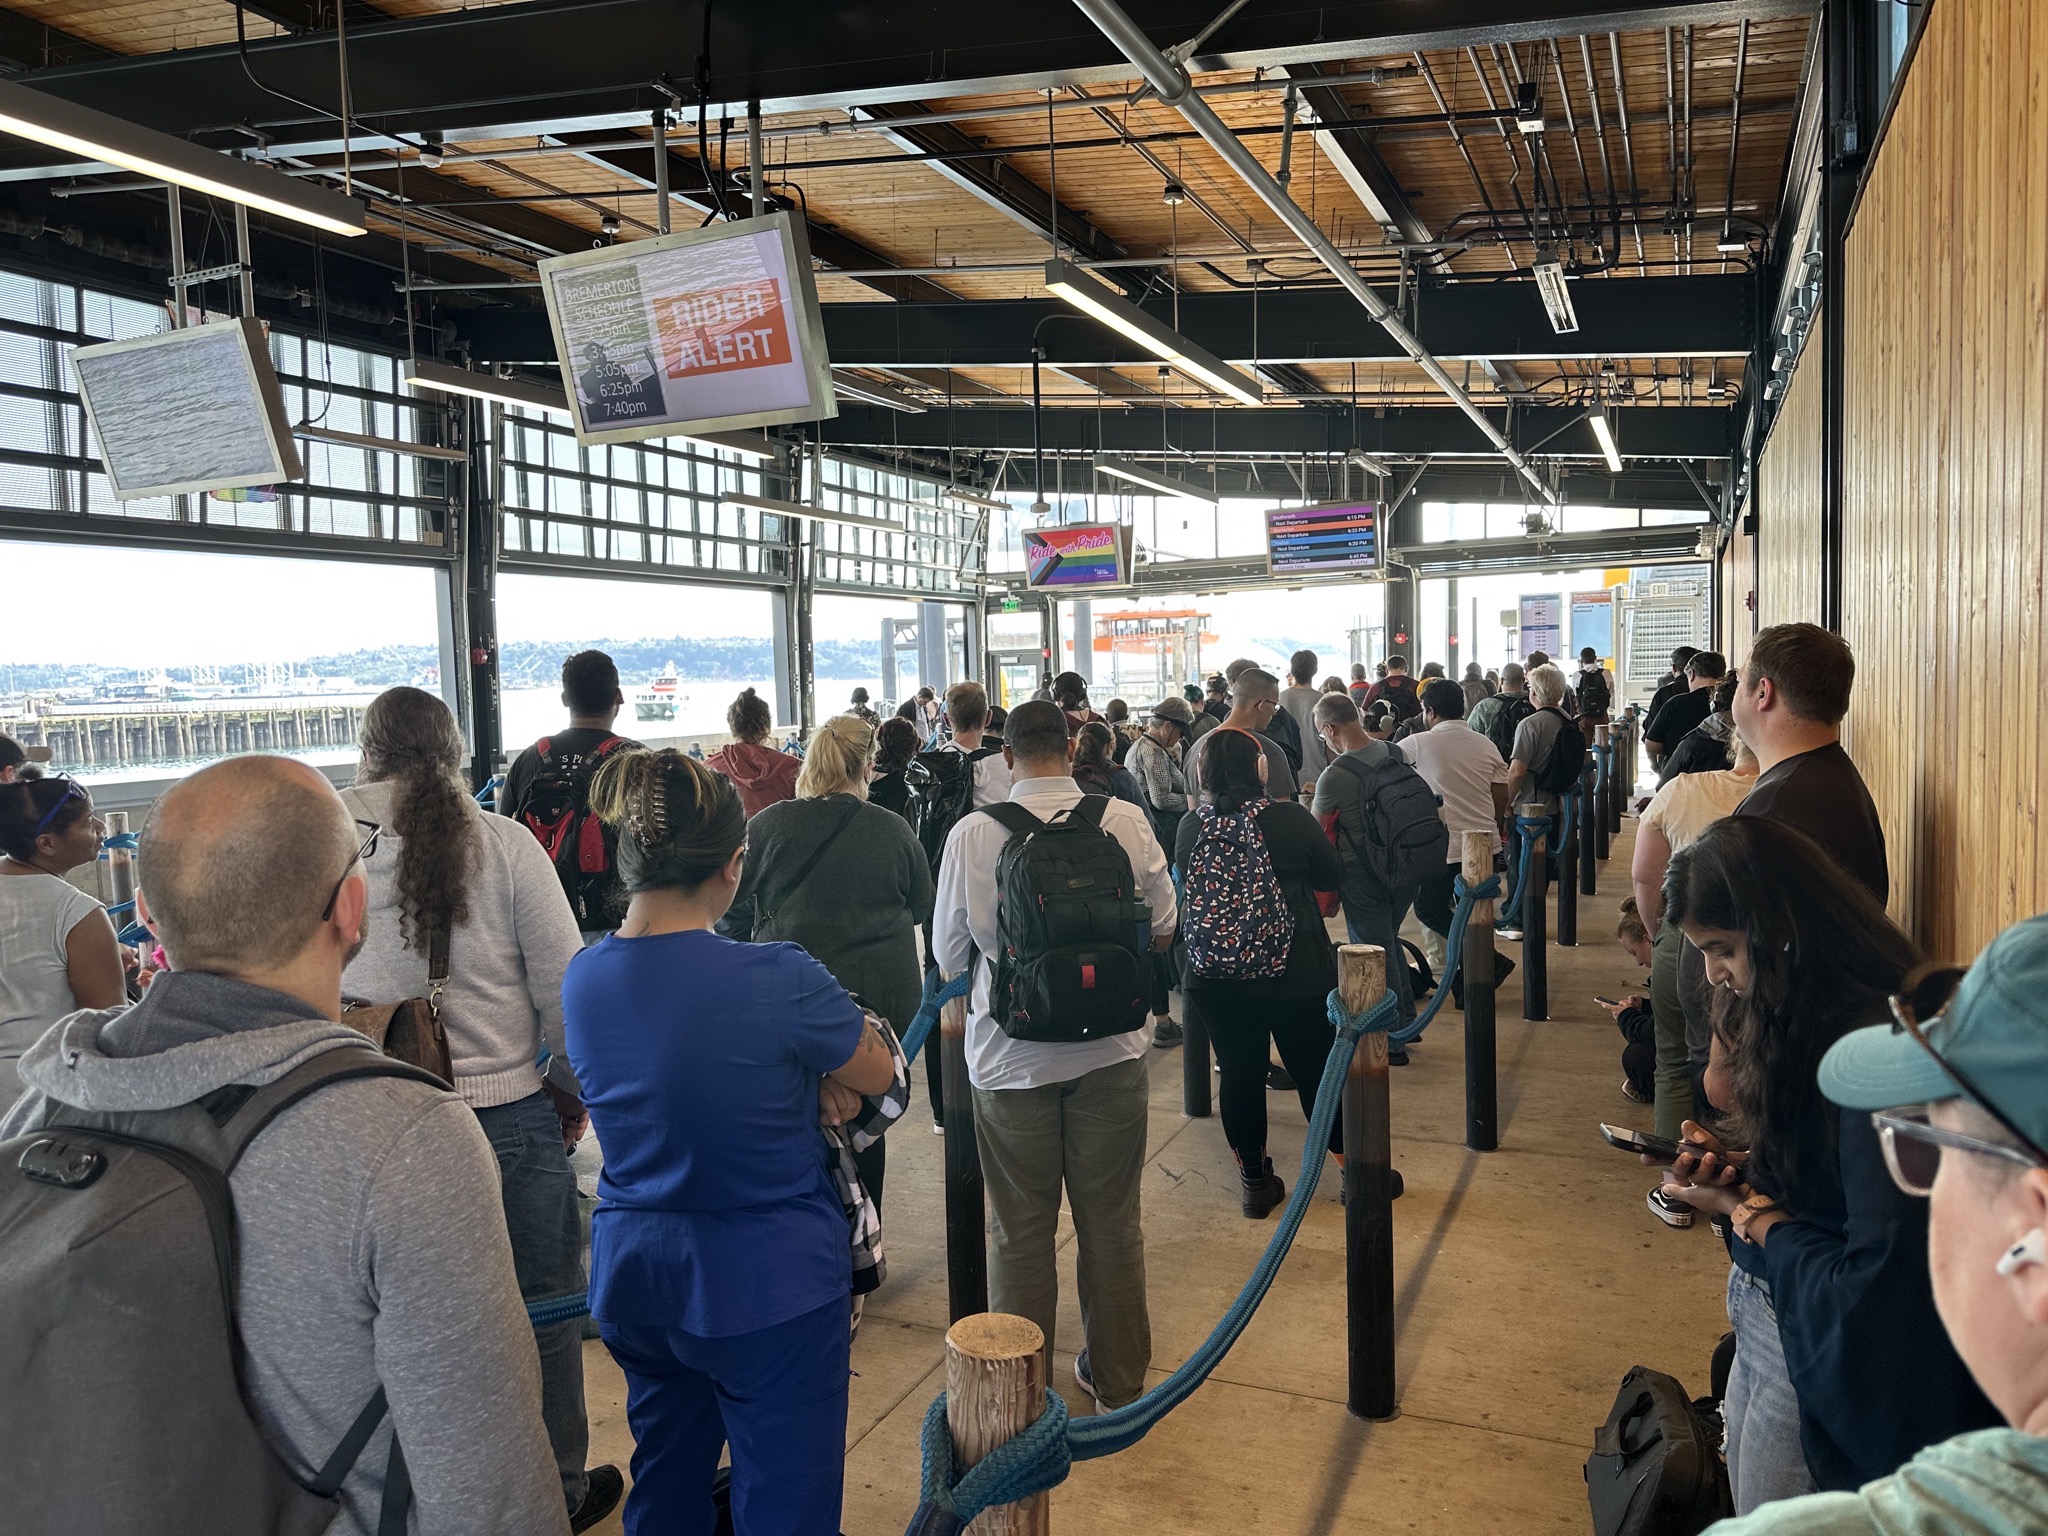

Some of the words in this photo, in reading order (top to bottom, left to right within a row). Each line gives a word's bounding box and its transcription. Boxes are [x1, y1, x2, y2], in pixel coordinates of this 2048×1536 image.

[565, 278, 636, 303] BREMERTON
[575, 298, 635, 321] SCHEDULE
[672, 288, 766, 331] RIDER
[591, 343, 635, 361] 3:45pm
[679, 328, 774, 371] ALERT
[595, 361, 639, 379] 5:05pm
[600, 380, 644, 398] 6:25pm
[603, 400, 648, 417] 7:40pm
[1030, 542, 1057, 560] Ride
[1059, 541, 1078, 554] with
[1077, 531, 1112, 551] Pride
[1652, 584, 1666, 595] EXIT
